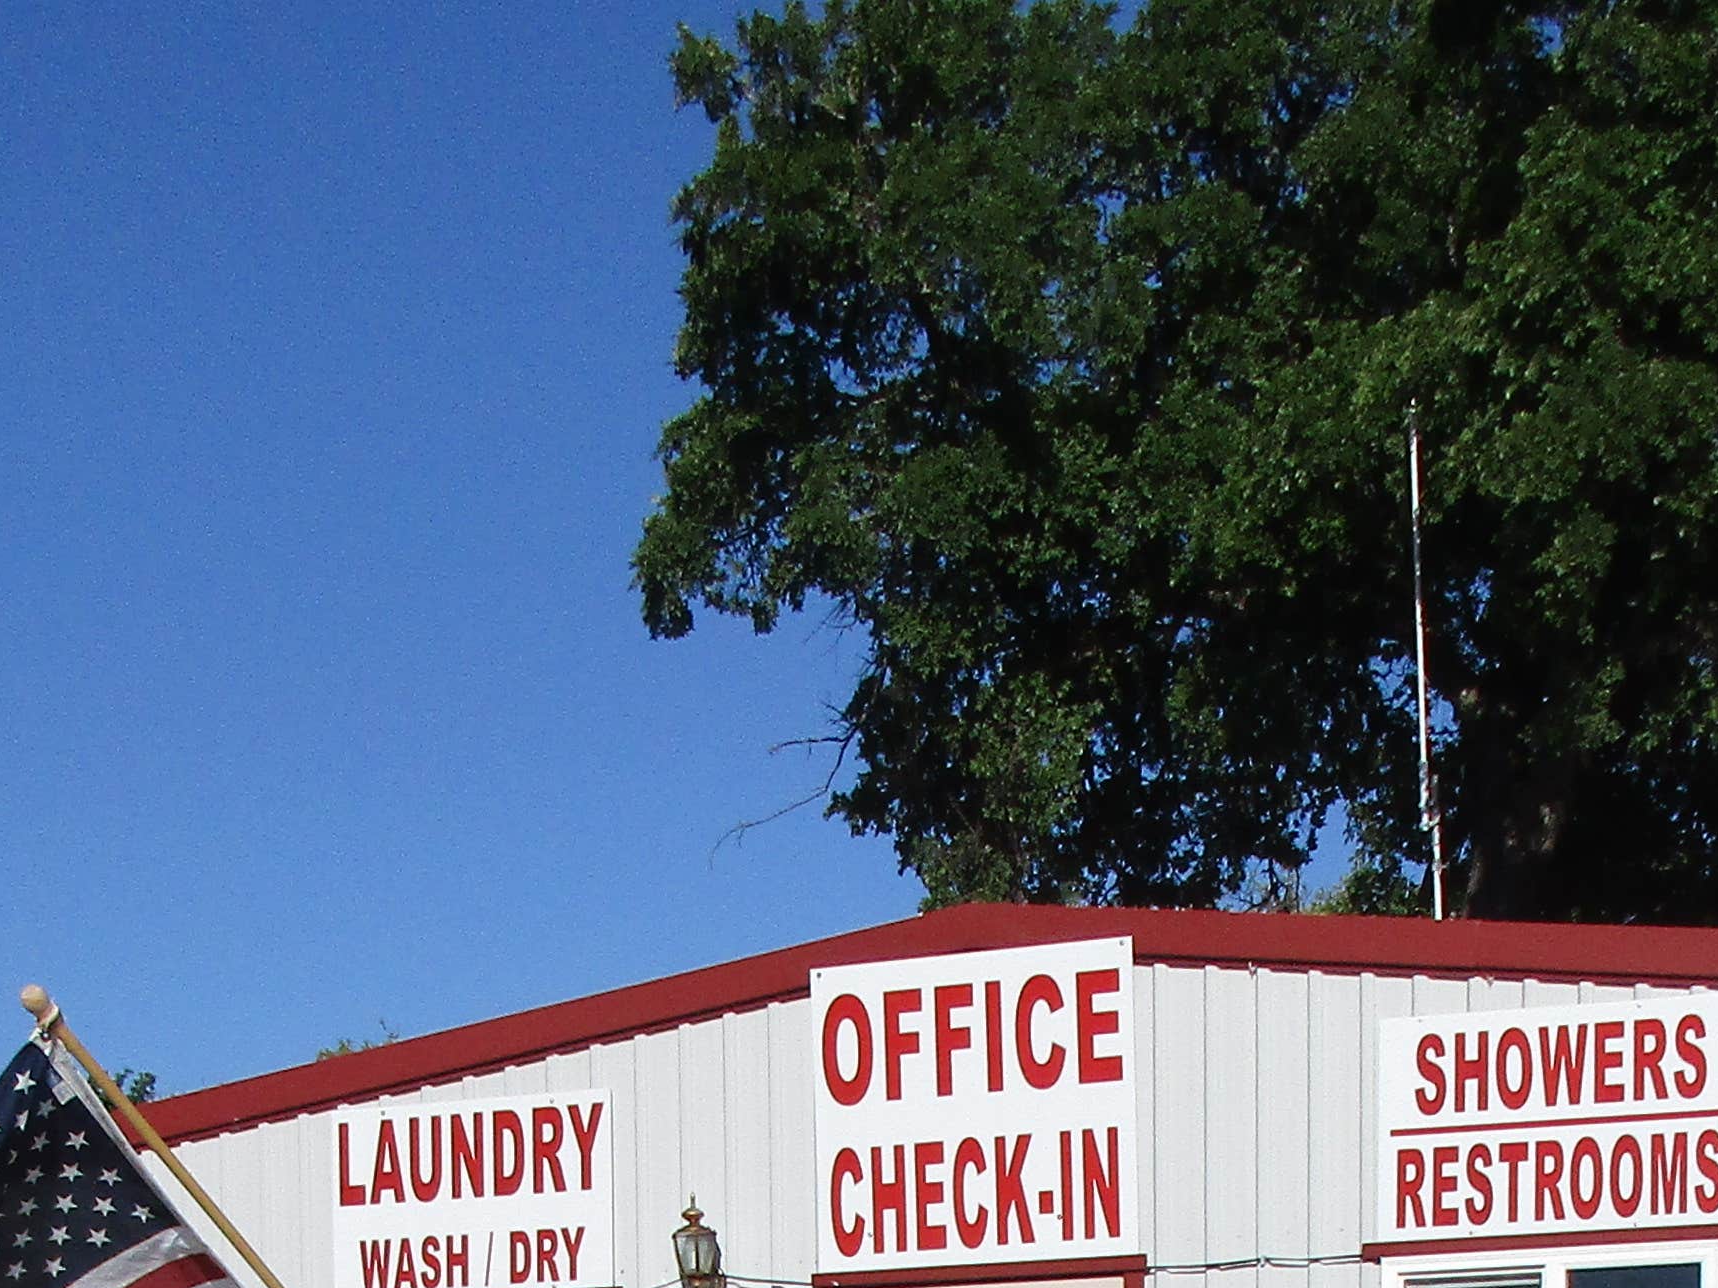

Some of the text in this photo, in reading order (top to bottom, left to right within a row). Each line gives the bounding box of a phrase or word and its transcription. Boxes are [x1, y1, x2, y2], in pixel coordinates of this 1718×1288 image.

[821, 968, 1125, 1106] OFFICE
[1414, 1014, 1707, 1116] SHOWERS
[338, 1102, 604, 1207] LAUNDRY
[830, 1126, 1122, 1258] CHECK-IN
[484, 1231, 494, 1287] /
[509, 1226, 586, 1284] DRY
